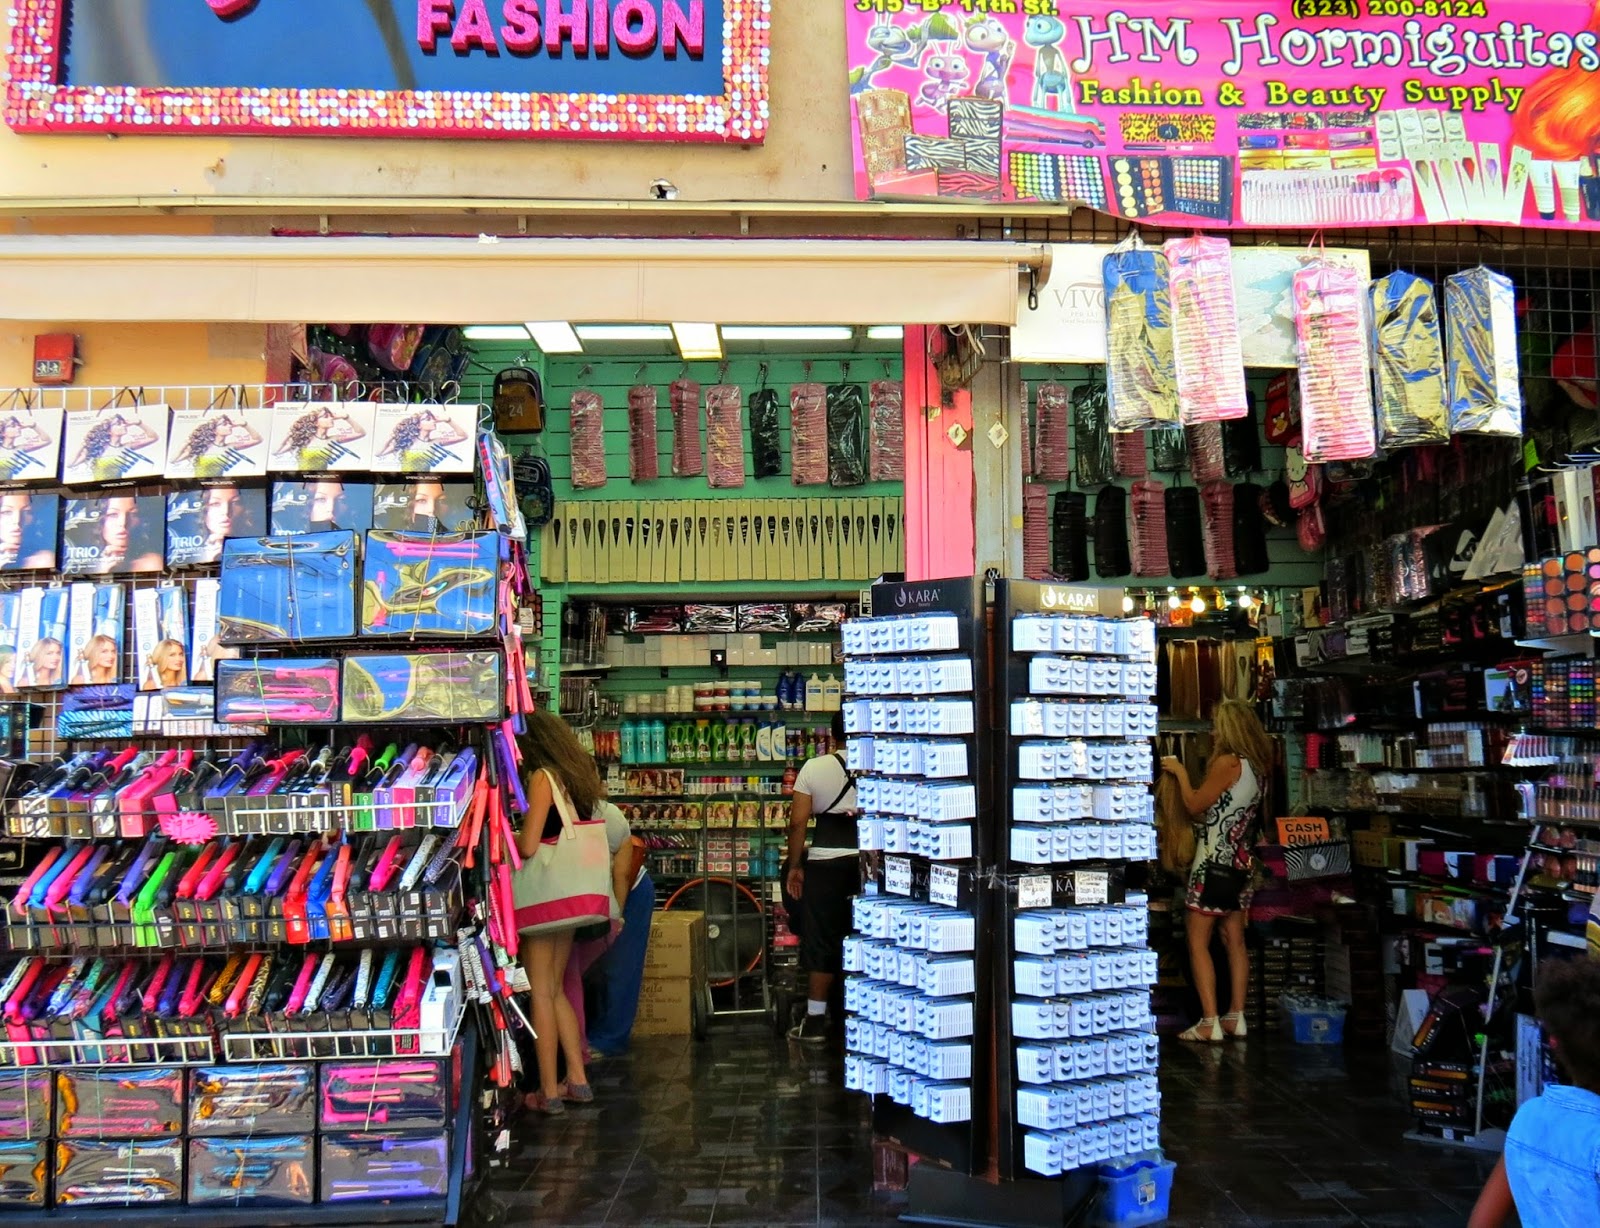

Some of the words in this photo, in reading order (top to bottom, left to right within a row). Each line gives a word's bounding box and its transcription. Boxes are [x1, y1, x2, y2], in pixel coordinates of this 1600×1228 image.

[1023, 0, 1058, 16] St.
[1292, 0, 1359, 18] (323)
[1369, 1, 1487, 17] 200-8124
[417, 0, 704, 56] FASHION
[1073, 11, 1199, 74] HM
[1220, 13, 1600, 77] Hormiguitas
[1080, 79, 1203, 106] Fashion
[1219, 81, 1244, 106] &
[1266, 80, 1386, 112] Beauty
[1404, 79, 1524, 112] Supply
[173, 535, 203, 548] TRIO
[68, 545, 99, 559] TRIO
[908, 588, 940, 604] KARA
[1058, 592, 1094, 607] KARA
[1285, 823, 1322, 833] CASH
